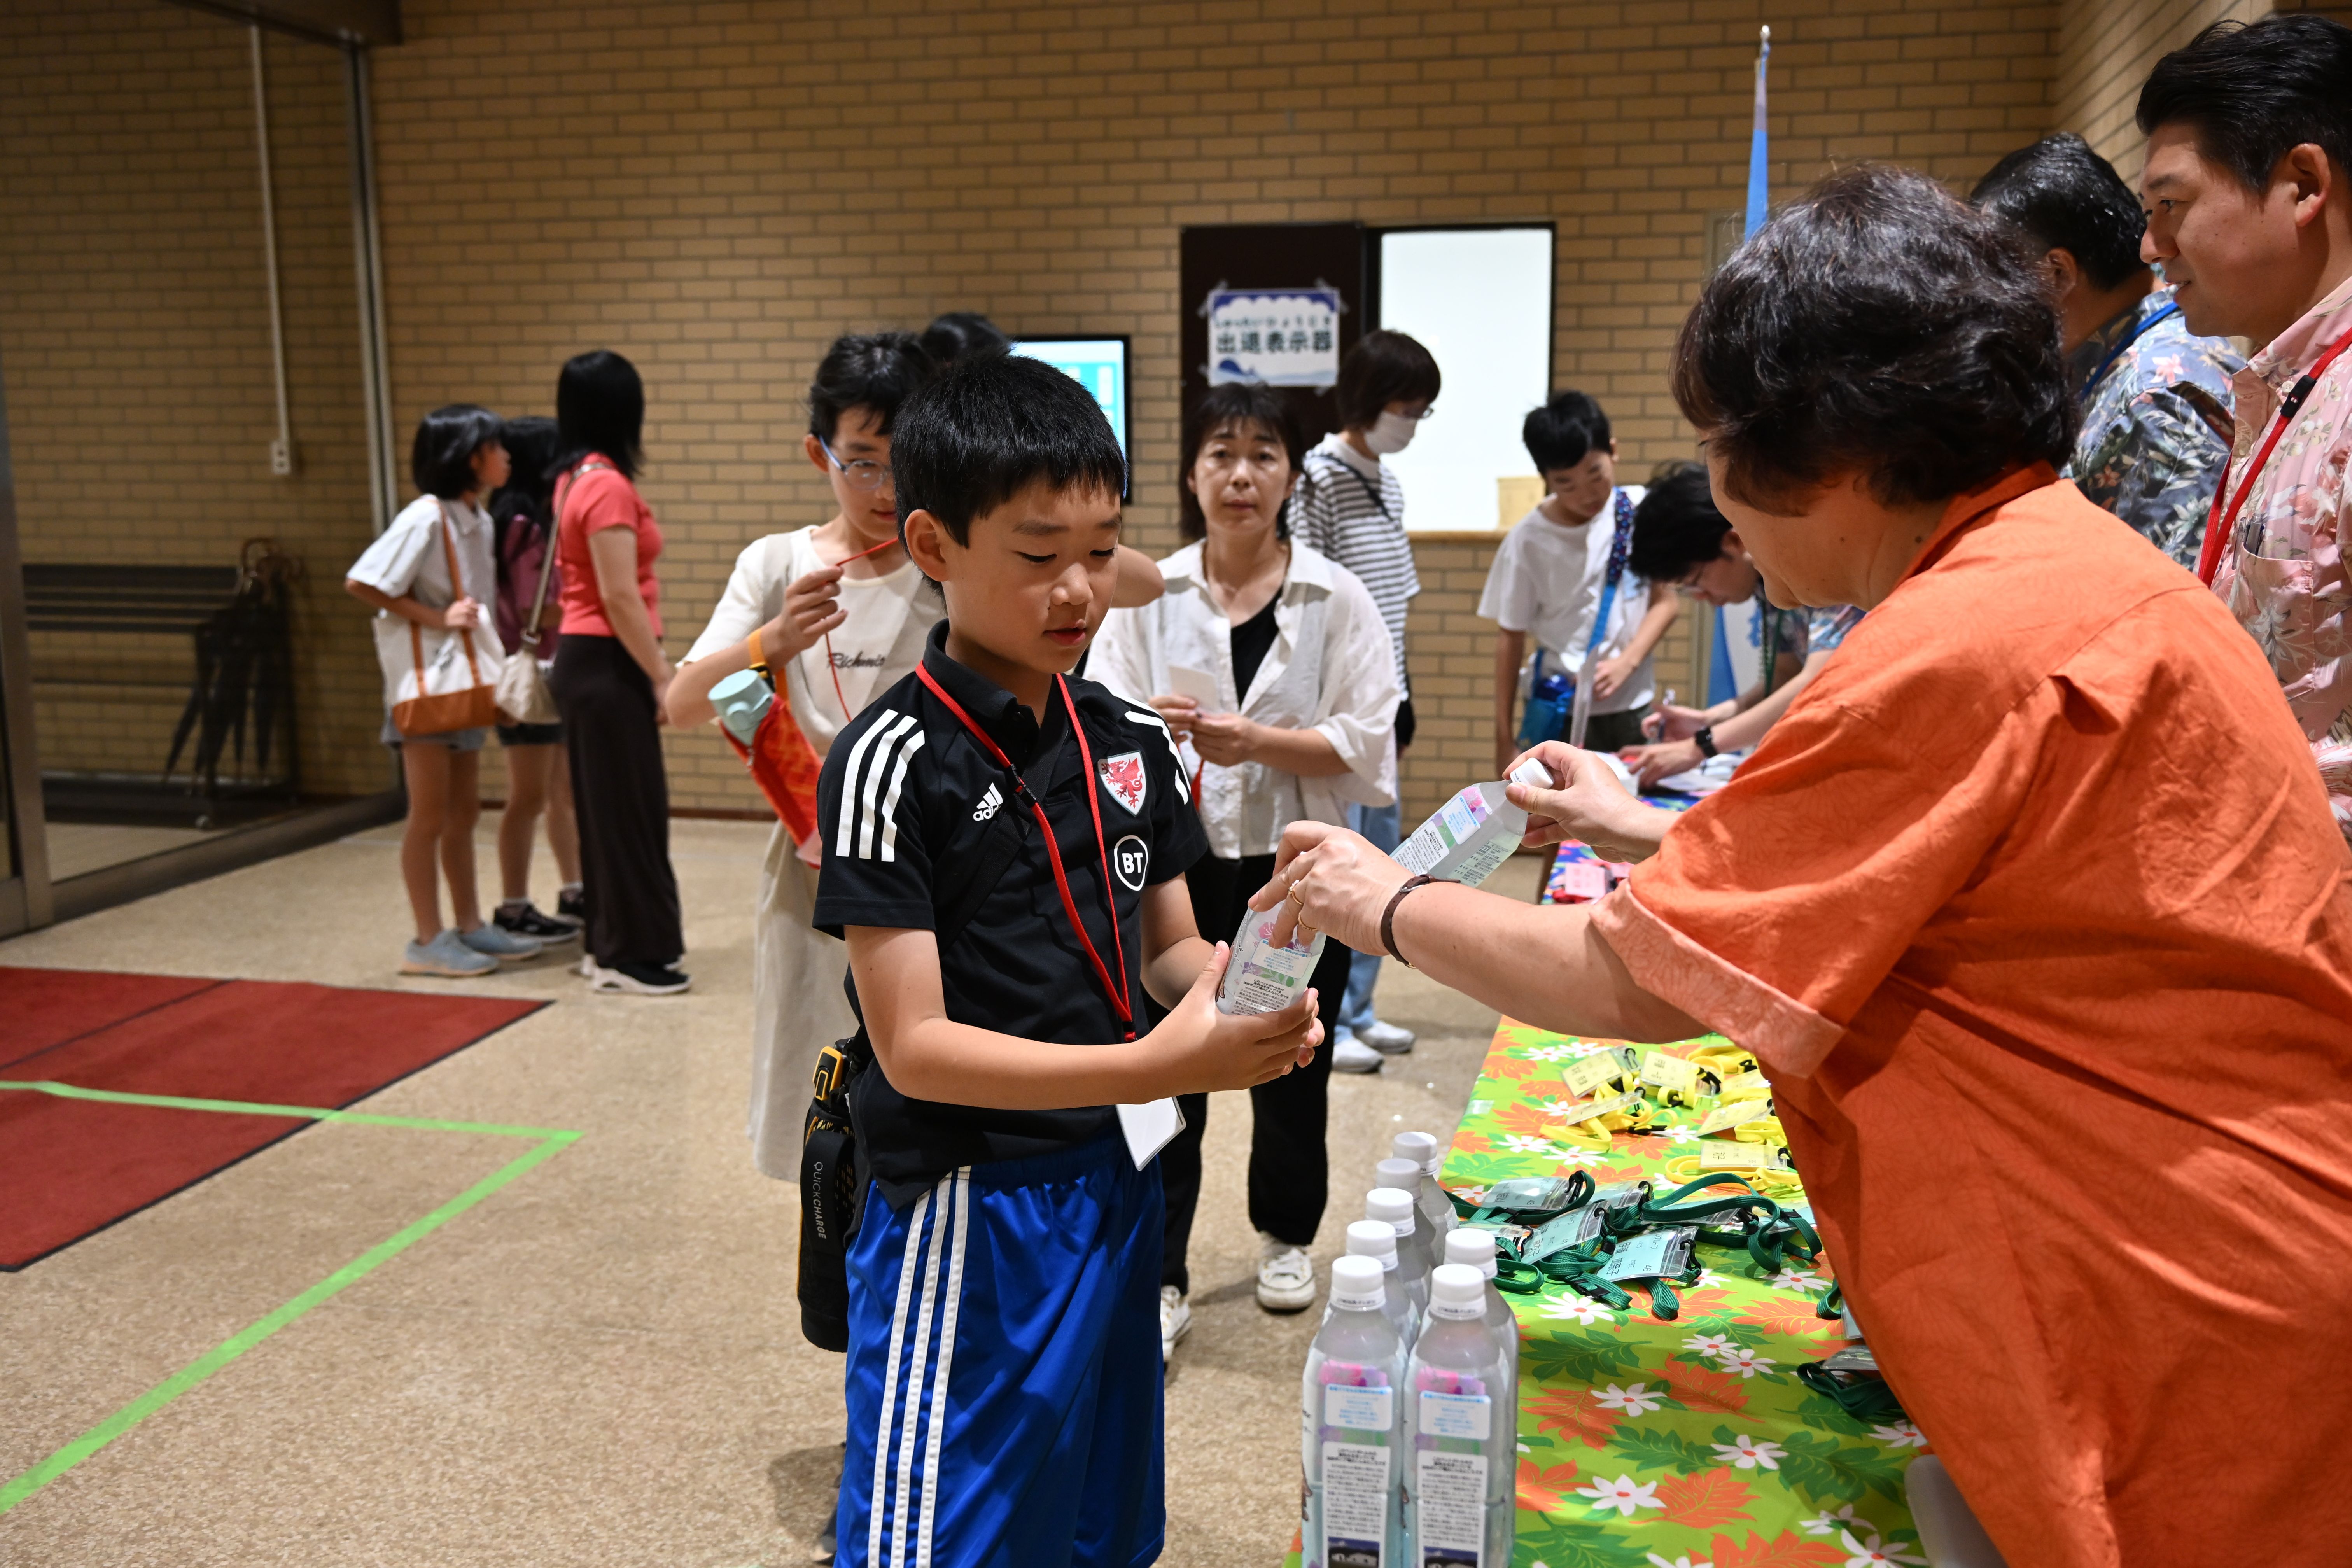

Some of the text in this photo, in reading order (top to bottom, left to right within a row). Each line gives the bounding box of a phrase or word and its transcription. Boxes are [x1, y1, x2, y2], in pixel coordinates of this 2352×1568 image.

[1217, 331, 1331, 353] 出退表示器
[1122, 852, 1143, 874] BT
[812, 1161, 827, 1239] QUICKCHARGE
